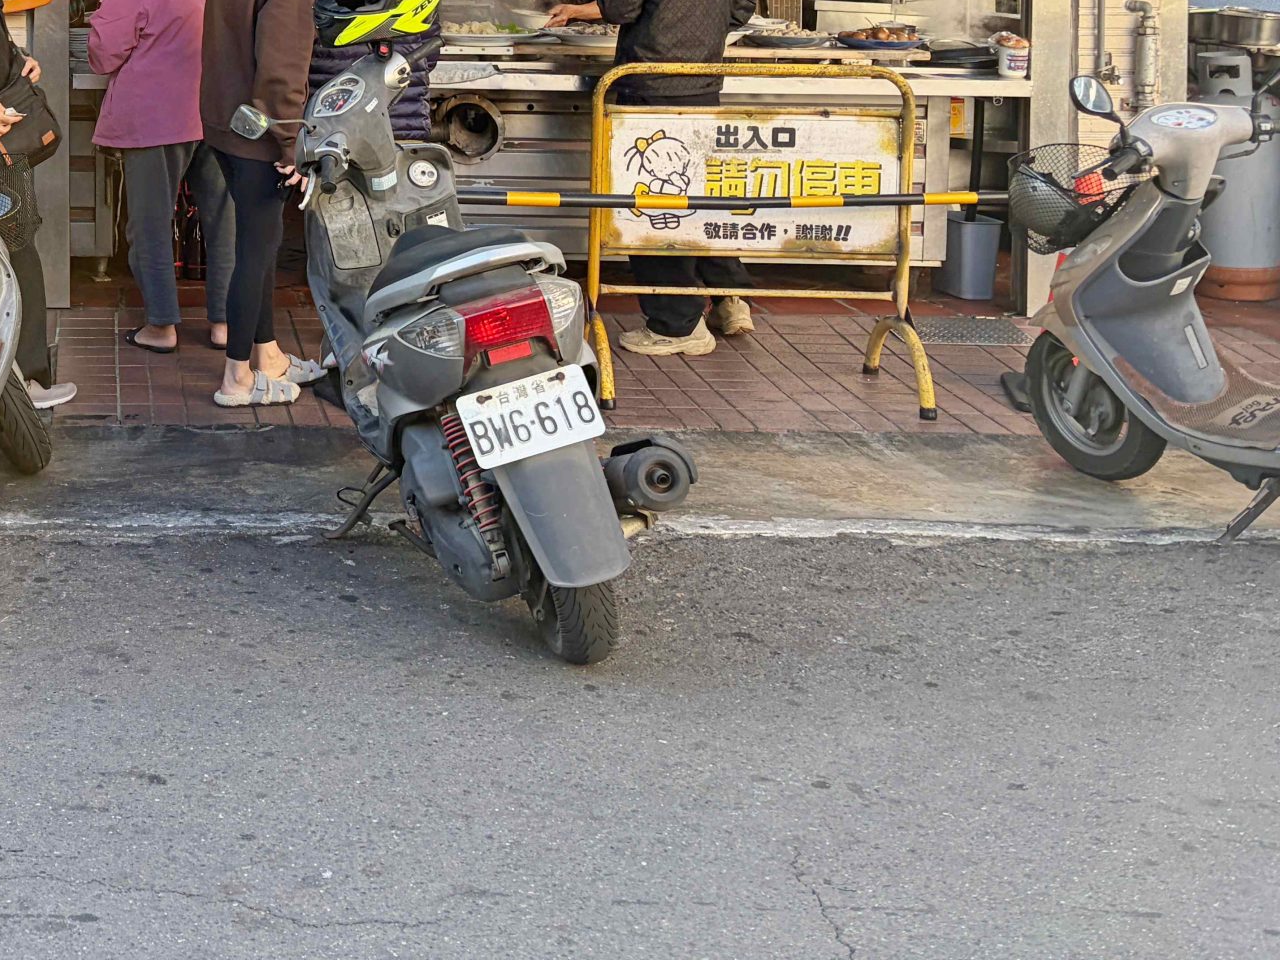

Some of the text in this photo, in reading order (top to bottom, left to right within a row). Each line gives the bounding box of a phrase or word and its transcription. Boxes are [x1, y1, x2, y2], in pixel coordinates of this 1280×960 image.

[715, 124, 797, 150] 出入口
[704, 158, 883, 215] 請勿停車
[496, 379, 546, 405] 台灣省
[468, 390, 596, 456] BW6-618
